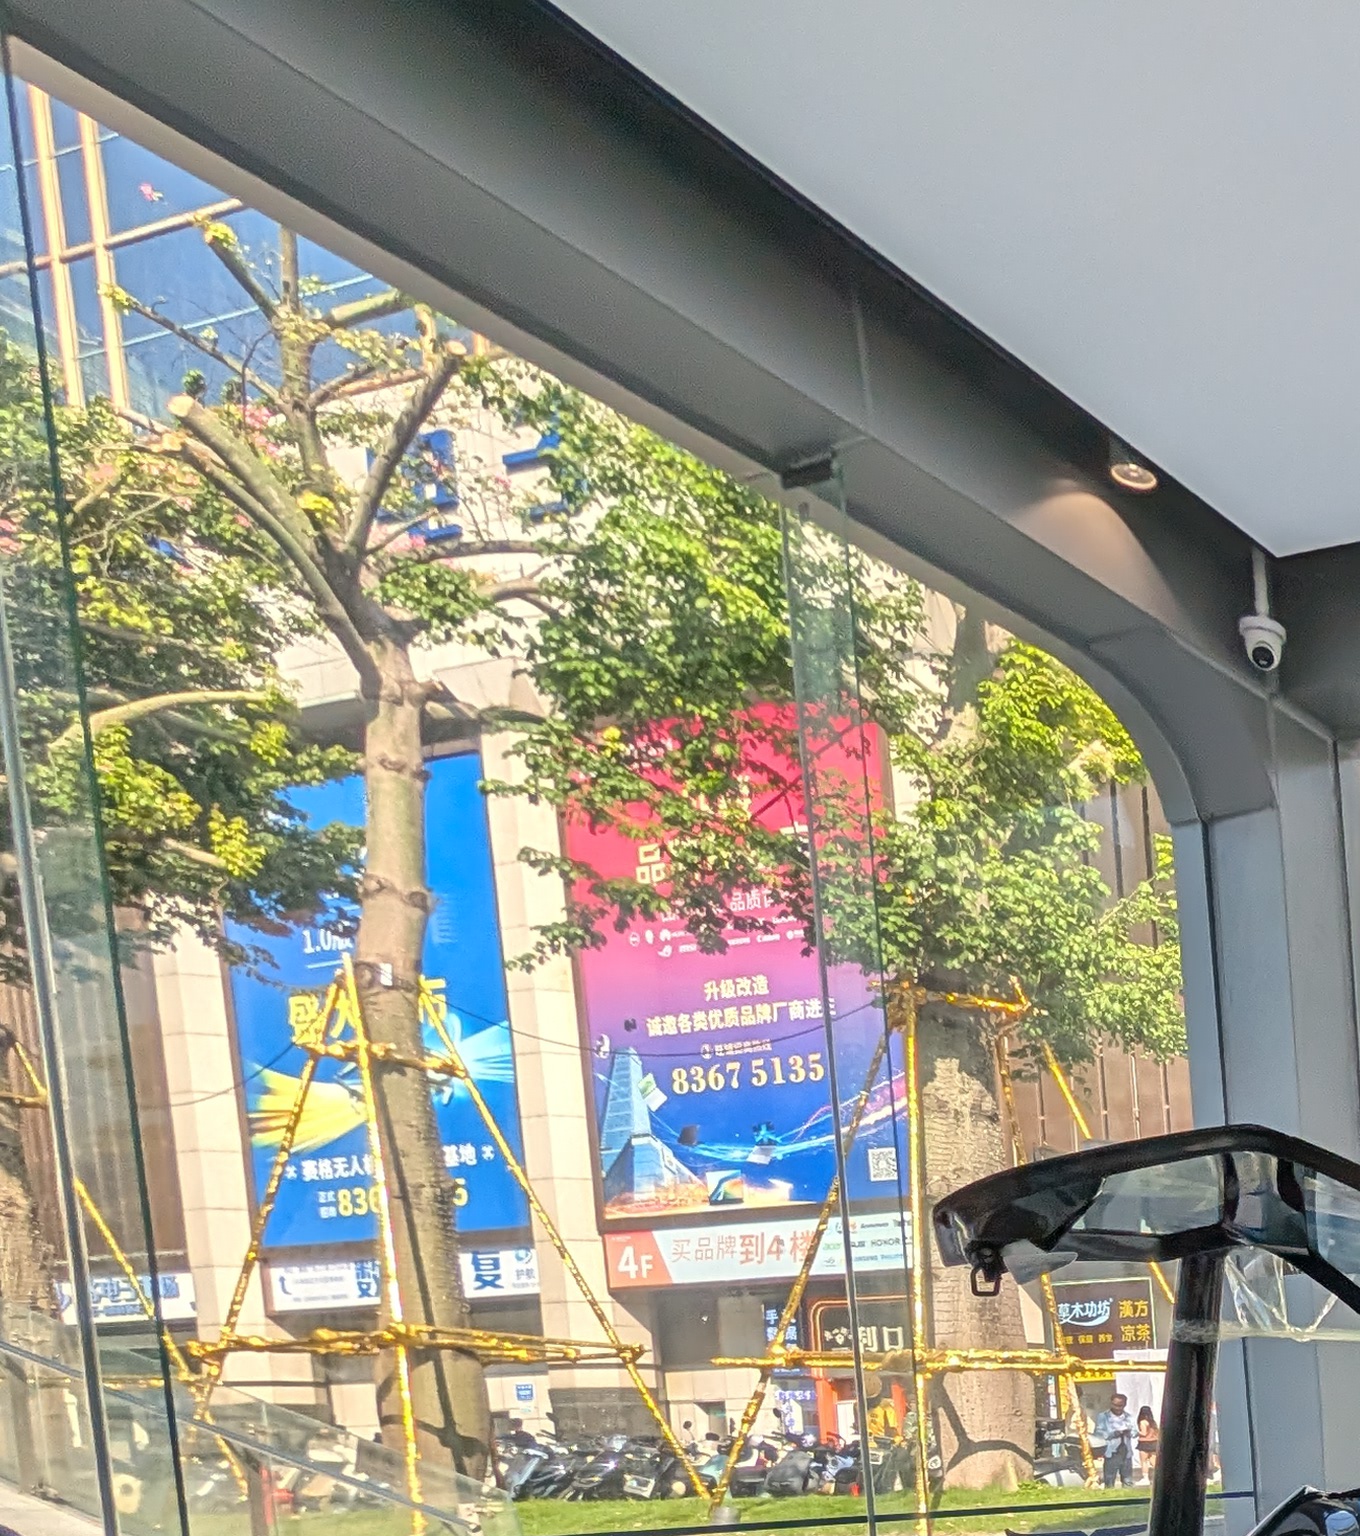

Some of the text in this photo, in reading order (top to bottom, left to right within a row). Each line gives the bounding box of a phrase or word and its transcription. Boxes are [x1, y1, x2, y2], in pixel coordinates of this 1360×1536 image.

[703, 974, 770, 1002] 升级改造
[671, 1052, 826, 1096] 8367 5135
[617, 1245, 653, 1280] 4F
[1120, 1323, 1151, 1343] 凉茶
